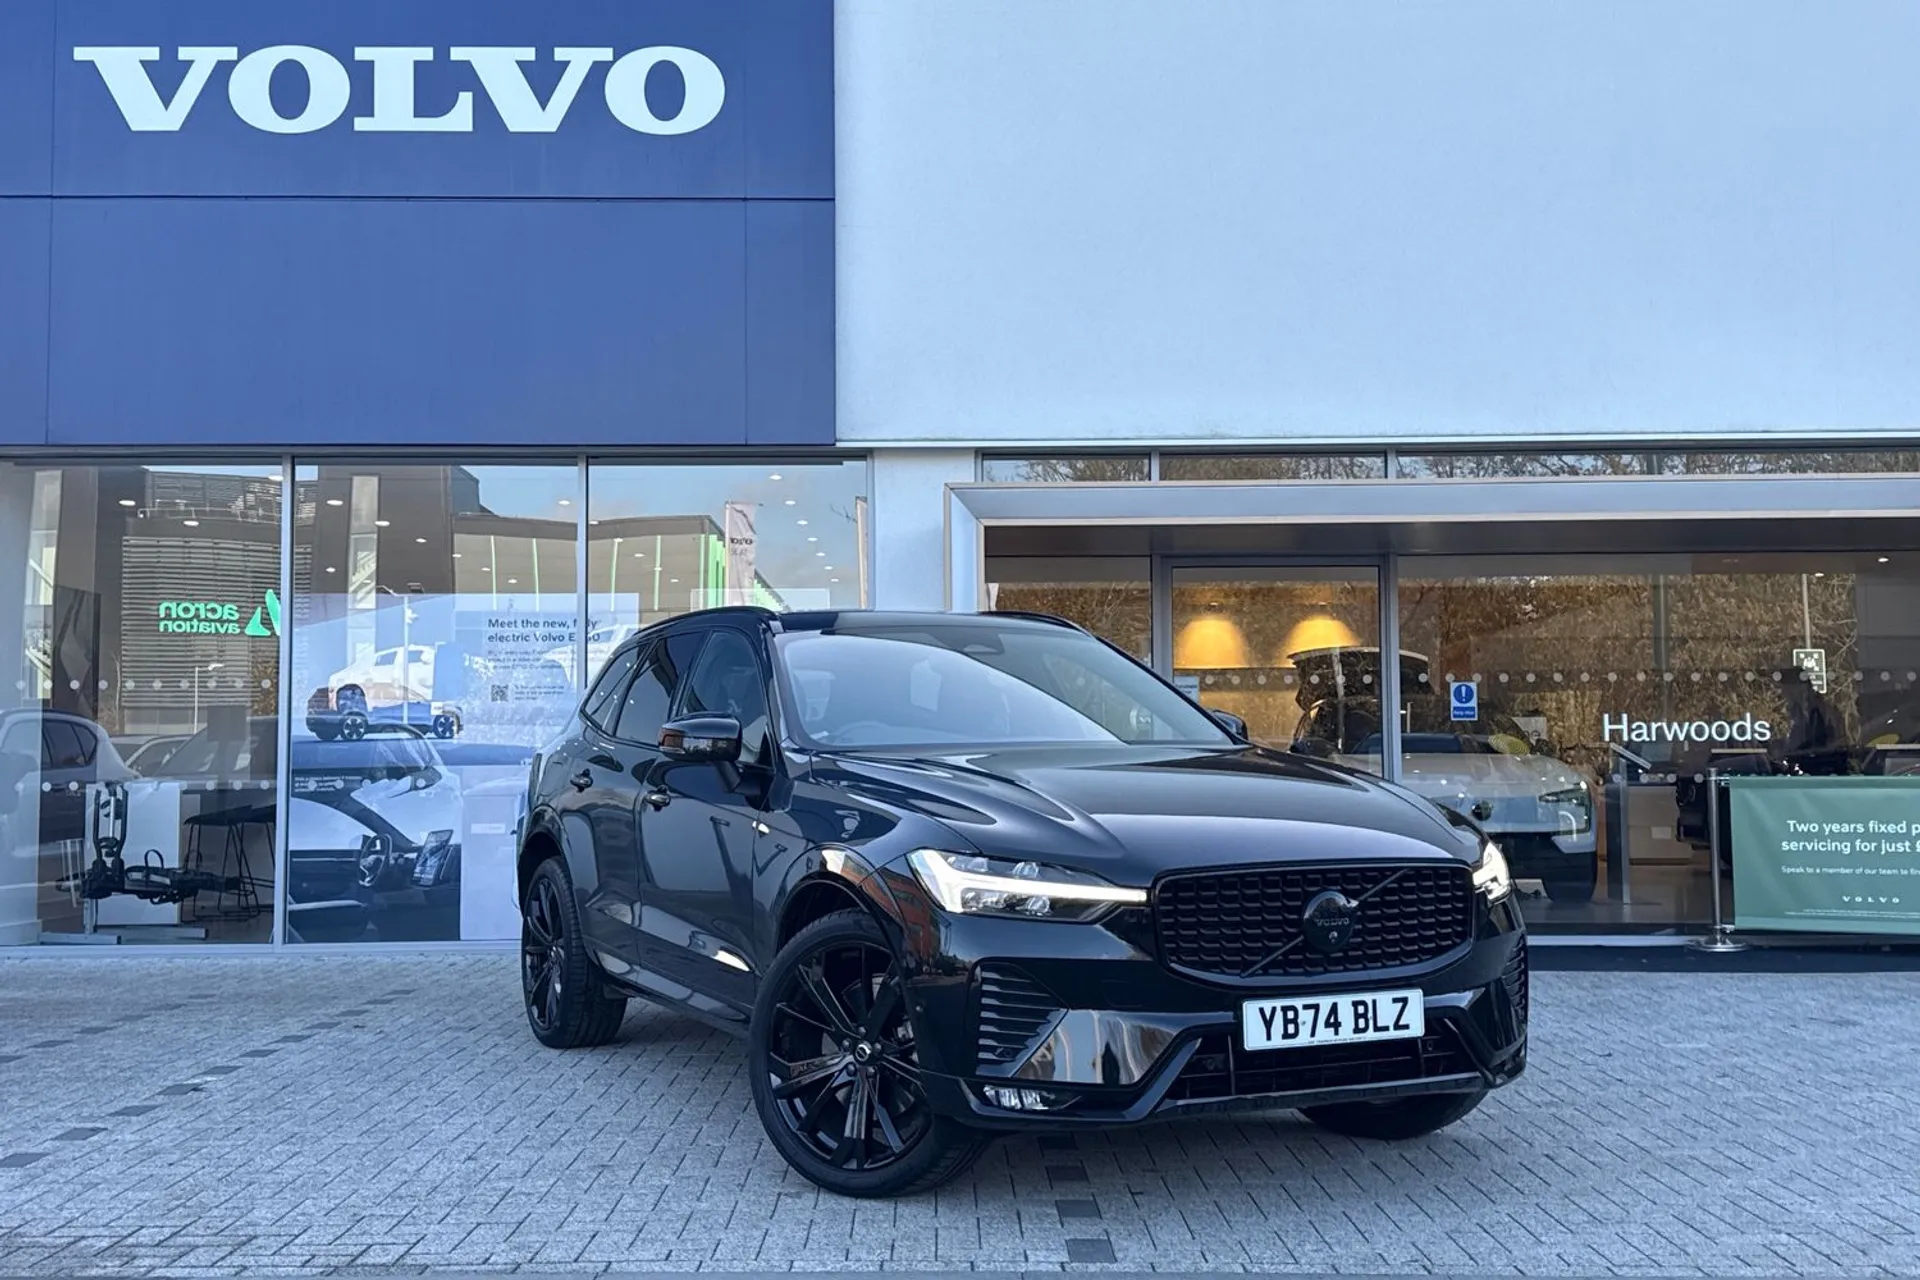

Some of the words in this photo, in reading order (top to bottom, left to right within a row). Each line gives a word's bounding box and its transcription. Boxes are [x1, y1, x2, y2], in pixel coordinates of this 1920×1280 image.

[73, 45, 725, 135] VOLVO
[487, 618, 518, 629] Meet
[521, 618, 540, 629] the
[543, 619, 570, 630] new,
[487, 632, 531, 643] electric
[533, 632, 565, 643] Volvo
[1602, 711, 1772, 743] Harwoods
[1786, 820, 1819, 833] Two
[1822, 822, 1865, 836] years
[1868, 820, 1907, 834] fixed
[1781, 839, 1851, 855] servicing
[1855, 839, 1878, 852] for
[1881, 839, 1911, 855] just
[1781, 865, 1805, 875] Speak
[1822, 866, 1854, 874] member
[1842, 895, 1900, 904] VOLVO
[1258, 1001, 1342, 1041] YB74
[1351, 996, 1410, 1034] BLZ
